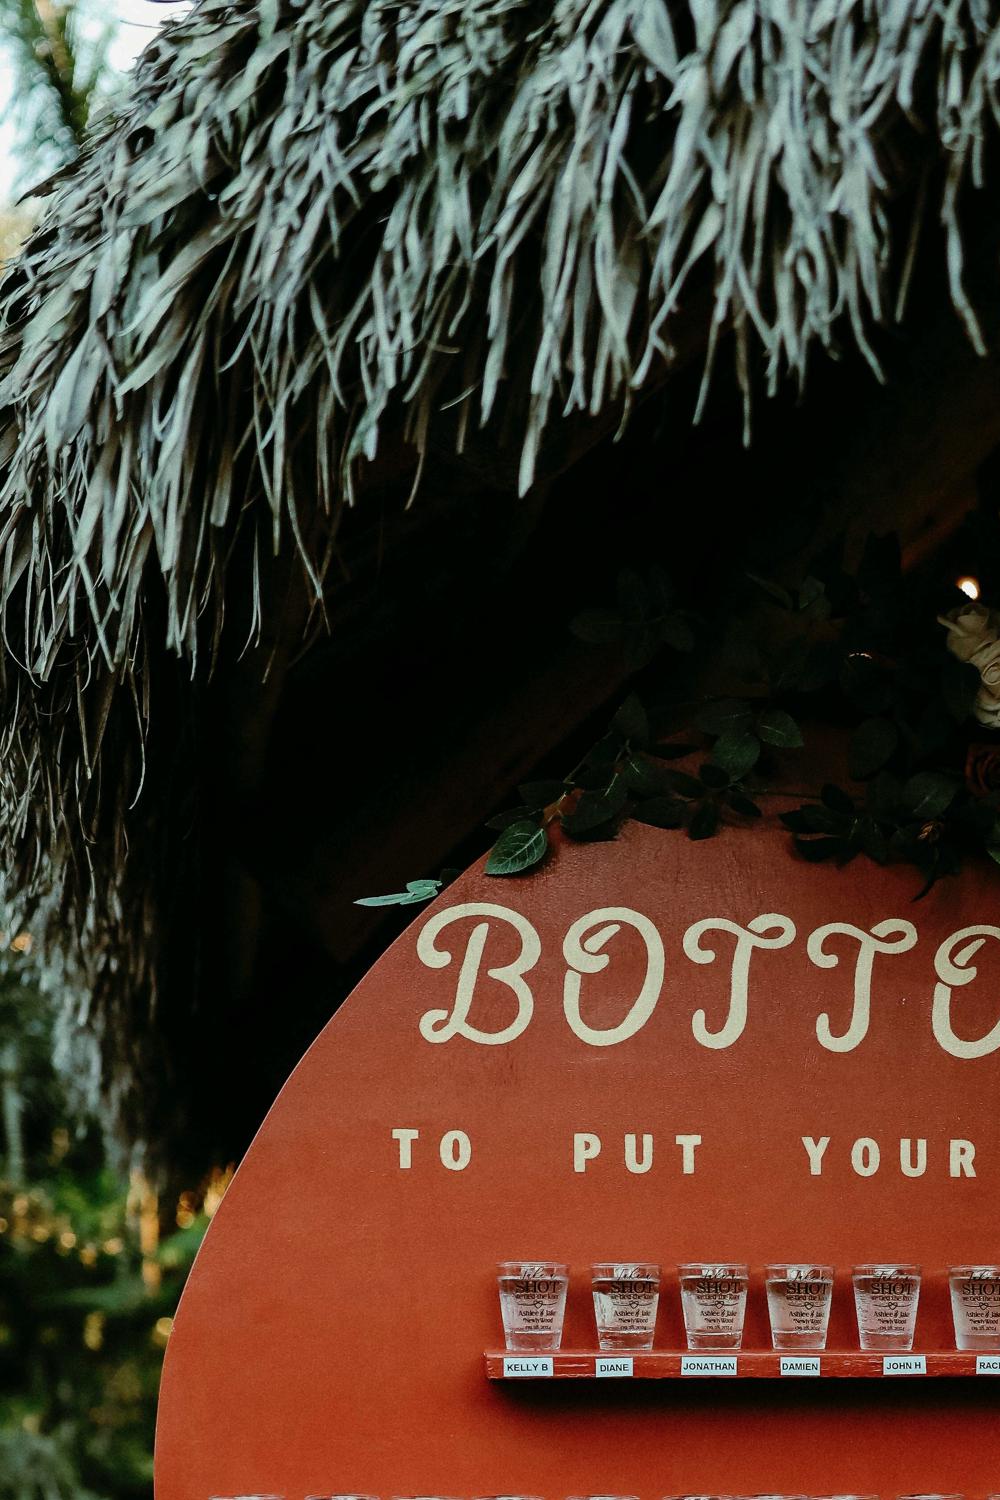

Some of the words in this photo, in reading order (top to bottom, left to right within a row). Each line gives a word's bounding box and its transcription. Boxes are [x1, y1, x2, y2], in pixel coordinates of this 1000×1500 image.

[392, 1128, 471, 1170] TO
[574, 1132, 700, 1174] PUT
[801, 1136, 976, 1178] YOUR
[516, 1280, 560, 1293] SHOT
[696, 1281, 740, 1294] SHOT
[786, 1283, 828, 1295] SHOT
[871, 1283, 913, 1295] SHOT
[506, 1363, 539, 1372] KELLY
[599, 1363, 630, 1373] DIANE
[683, 1362, 735, 1371] JONATHAN
[782, 1362, 818, 1371] DAMIEN
[886, 1361, 912, 1370] JOHN
